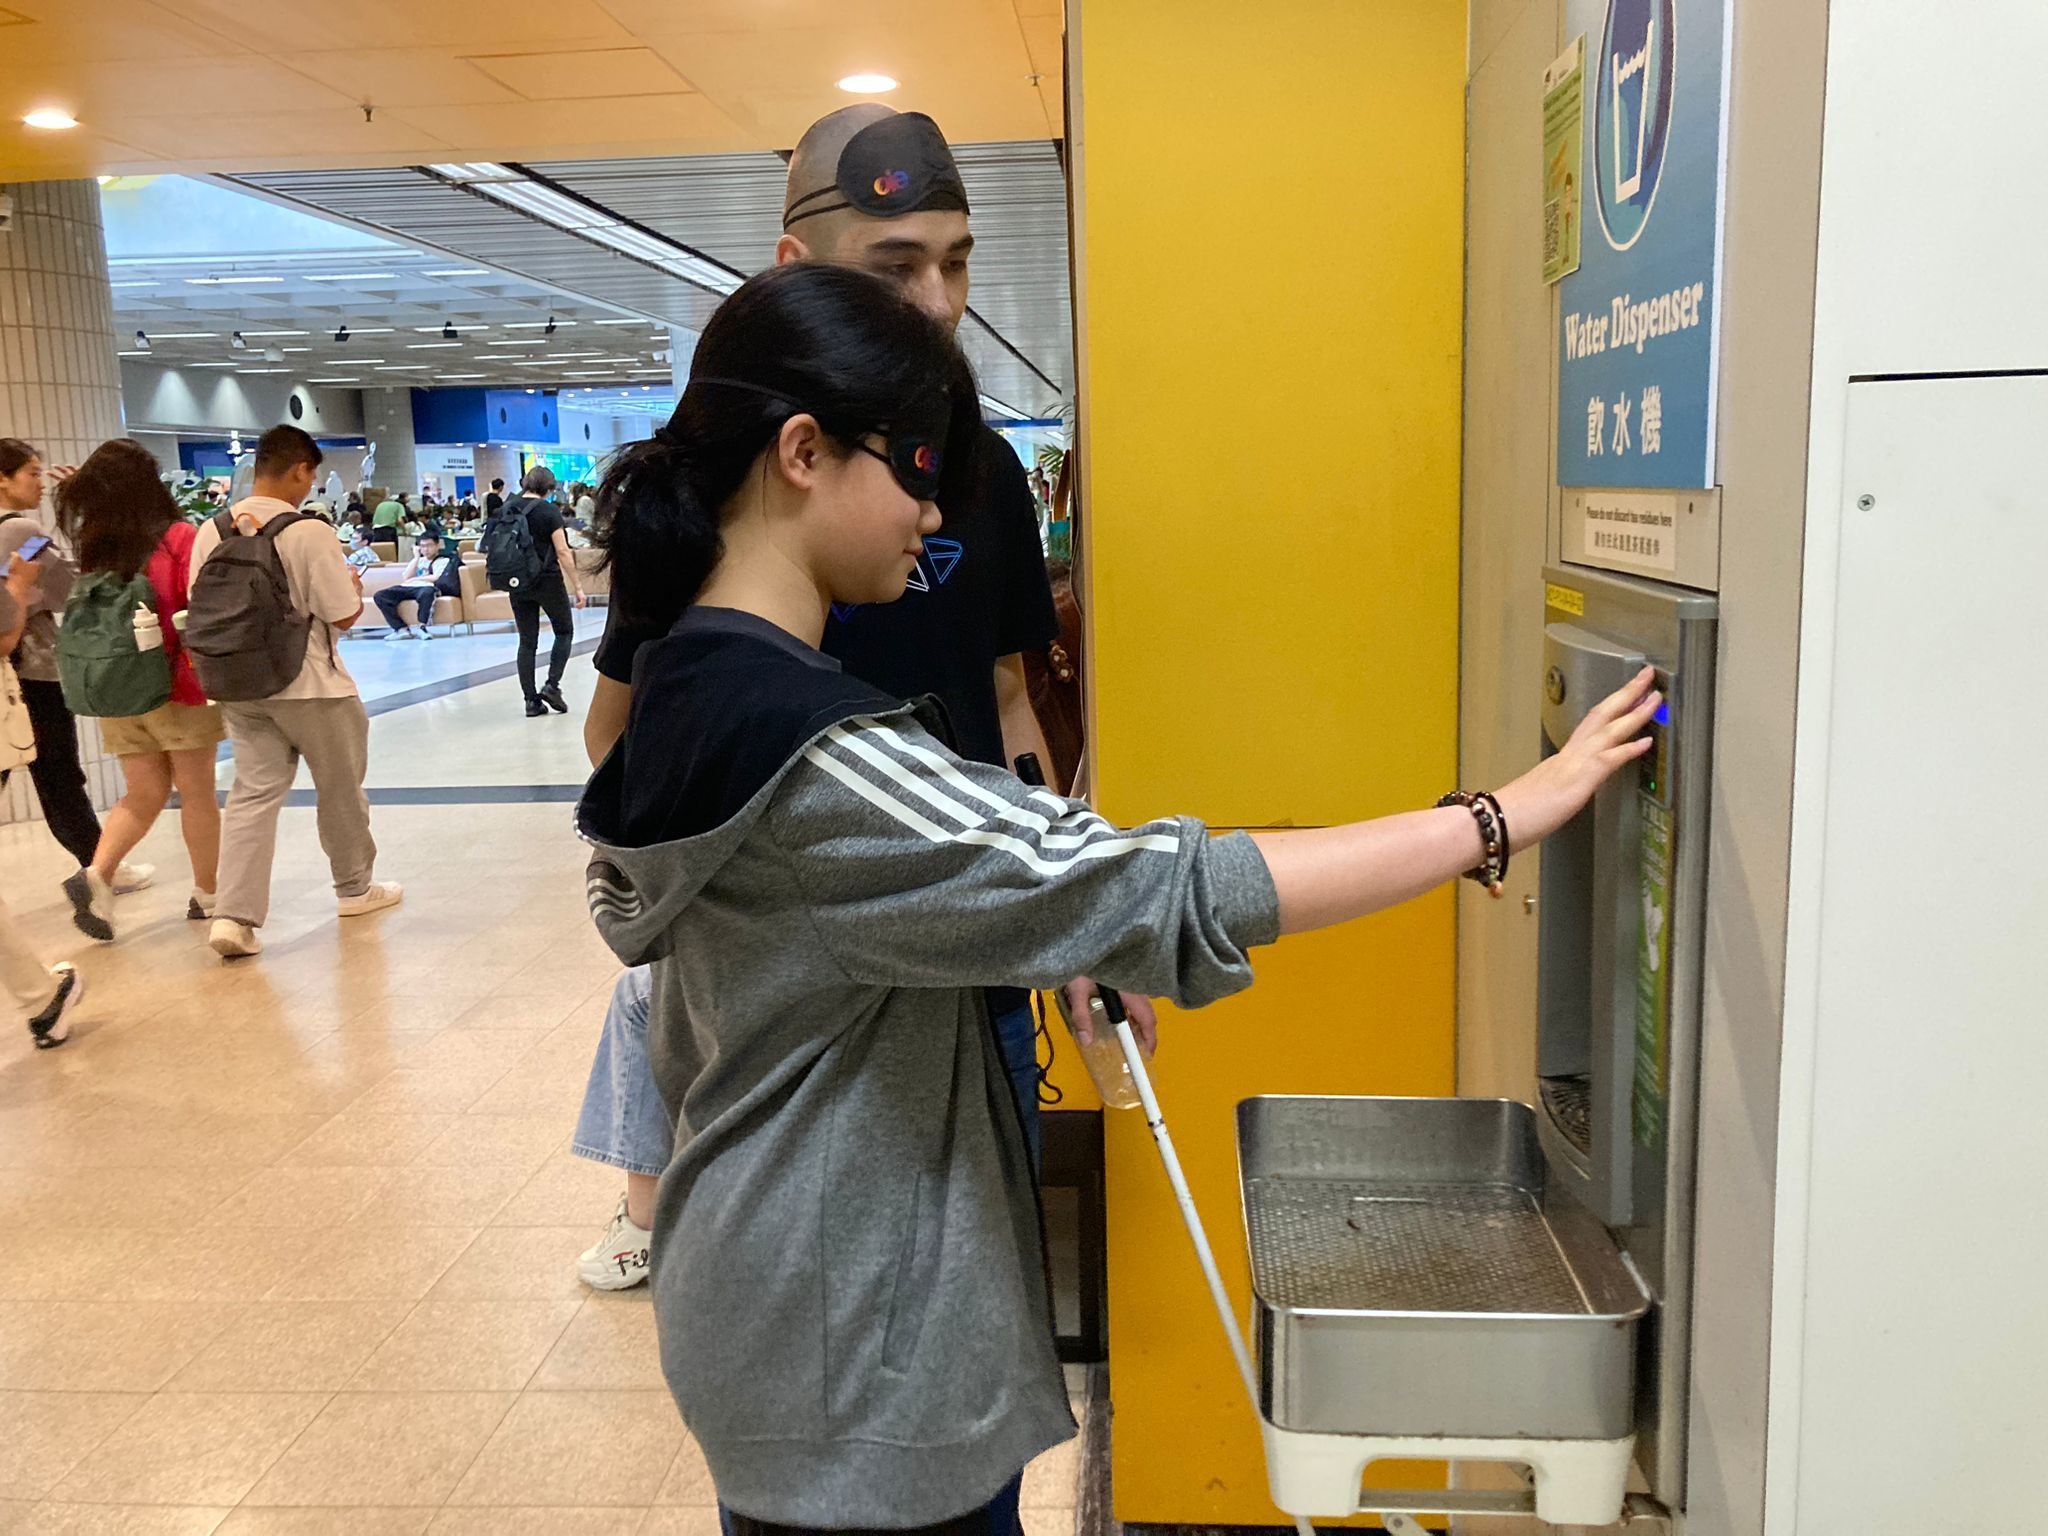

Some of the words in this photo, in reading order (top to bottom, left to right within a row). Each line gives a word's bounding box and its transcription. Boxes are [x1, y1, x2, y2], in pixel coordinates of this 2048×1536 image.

[1565, 313, 1608, 361] Water
[1611, 281, 1703, 354] Dispenser
[1588, 385, 1662, 457] 飲水機
